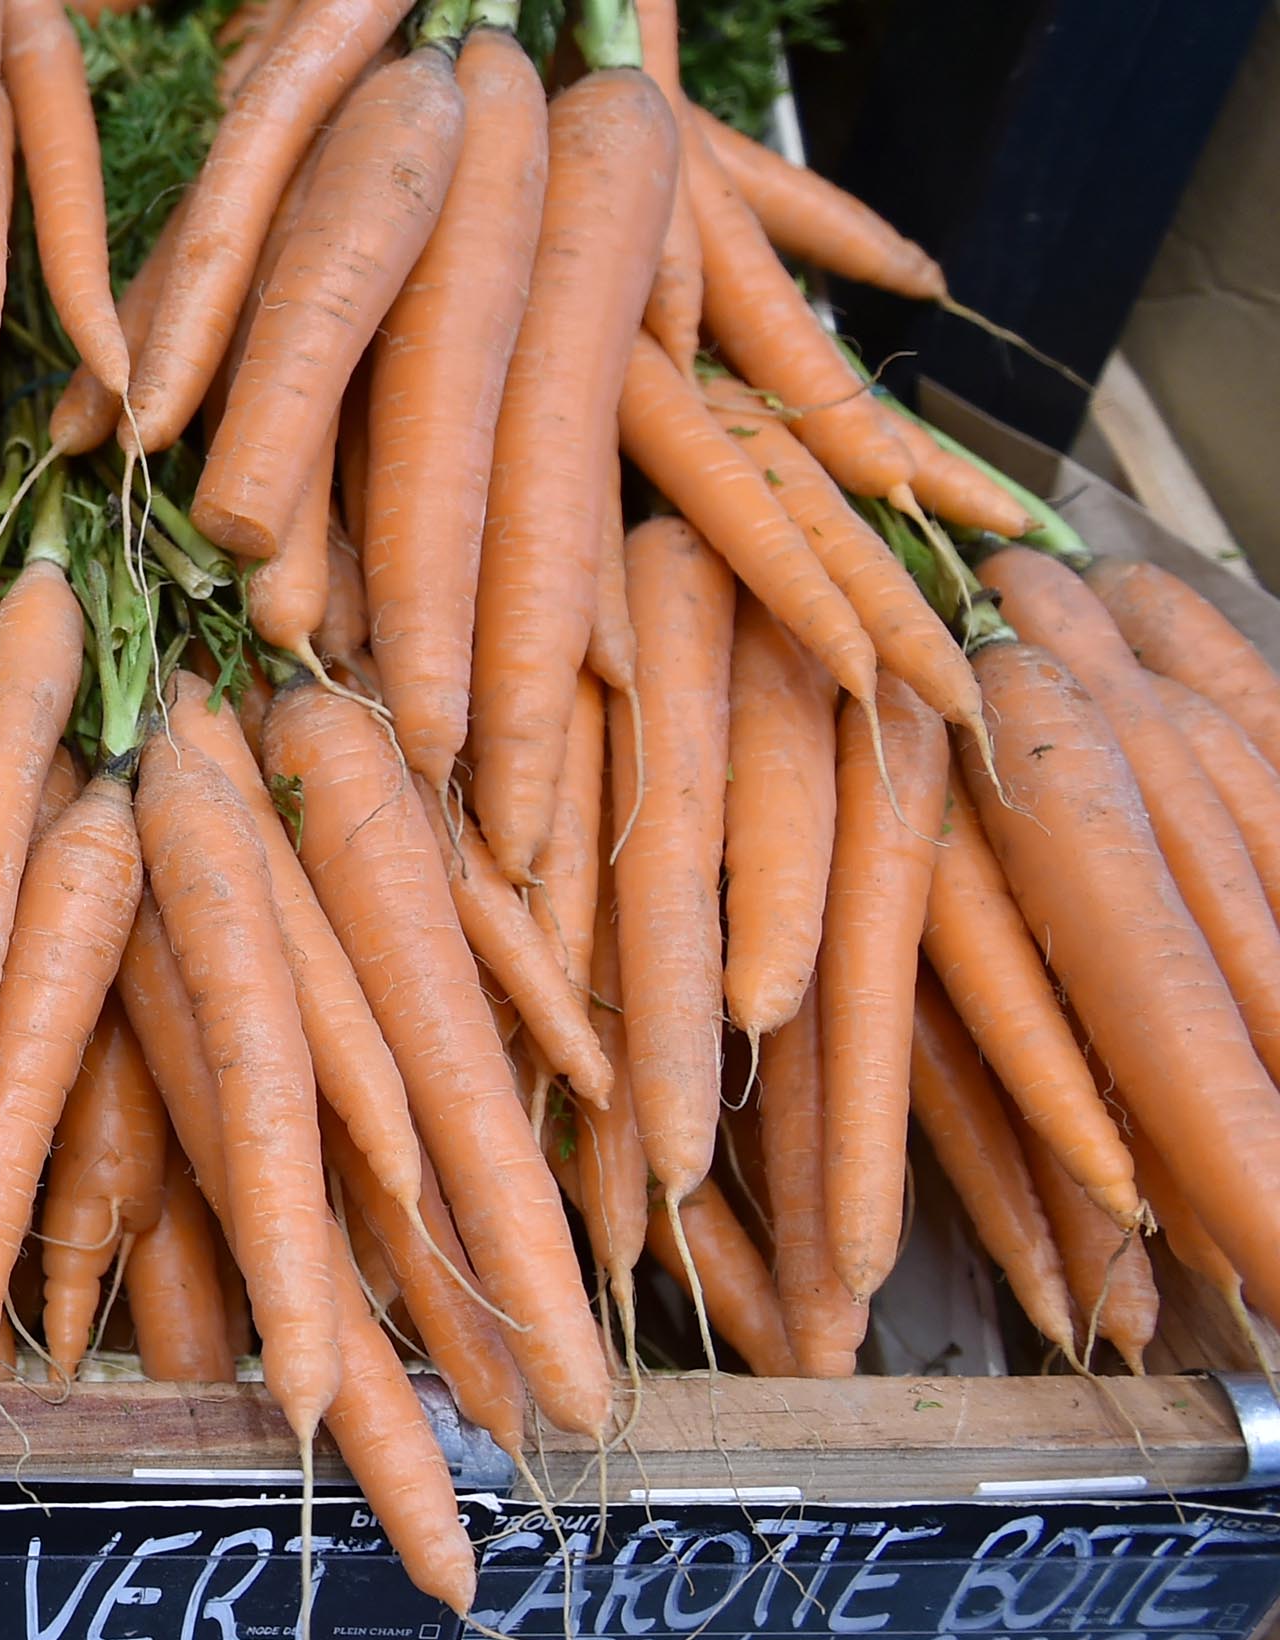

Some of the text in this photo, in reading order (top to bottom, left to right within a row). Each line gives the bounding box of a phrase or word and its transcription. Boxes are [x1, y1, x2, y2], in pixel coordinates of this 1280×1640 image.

[24, 1527, 383, 1640] VERT
[246, 1626, 279, 1636] MODE
[333, 1626, 413, 1637] PLEIN CHAMP
